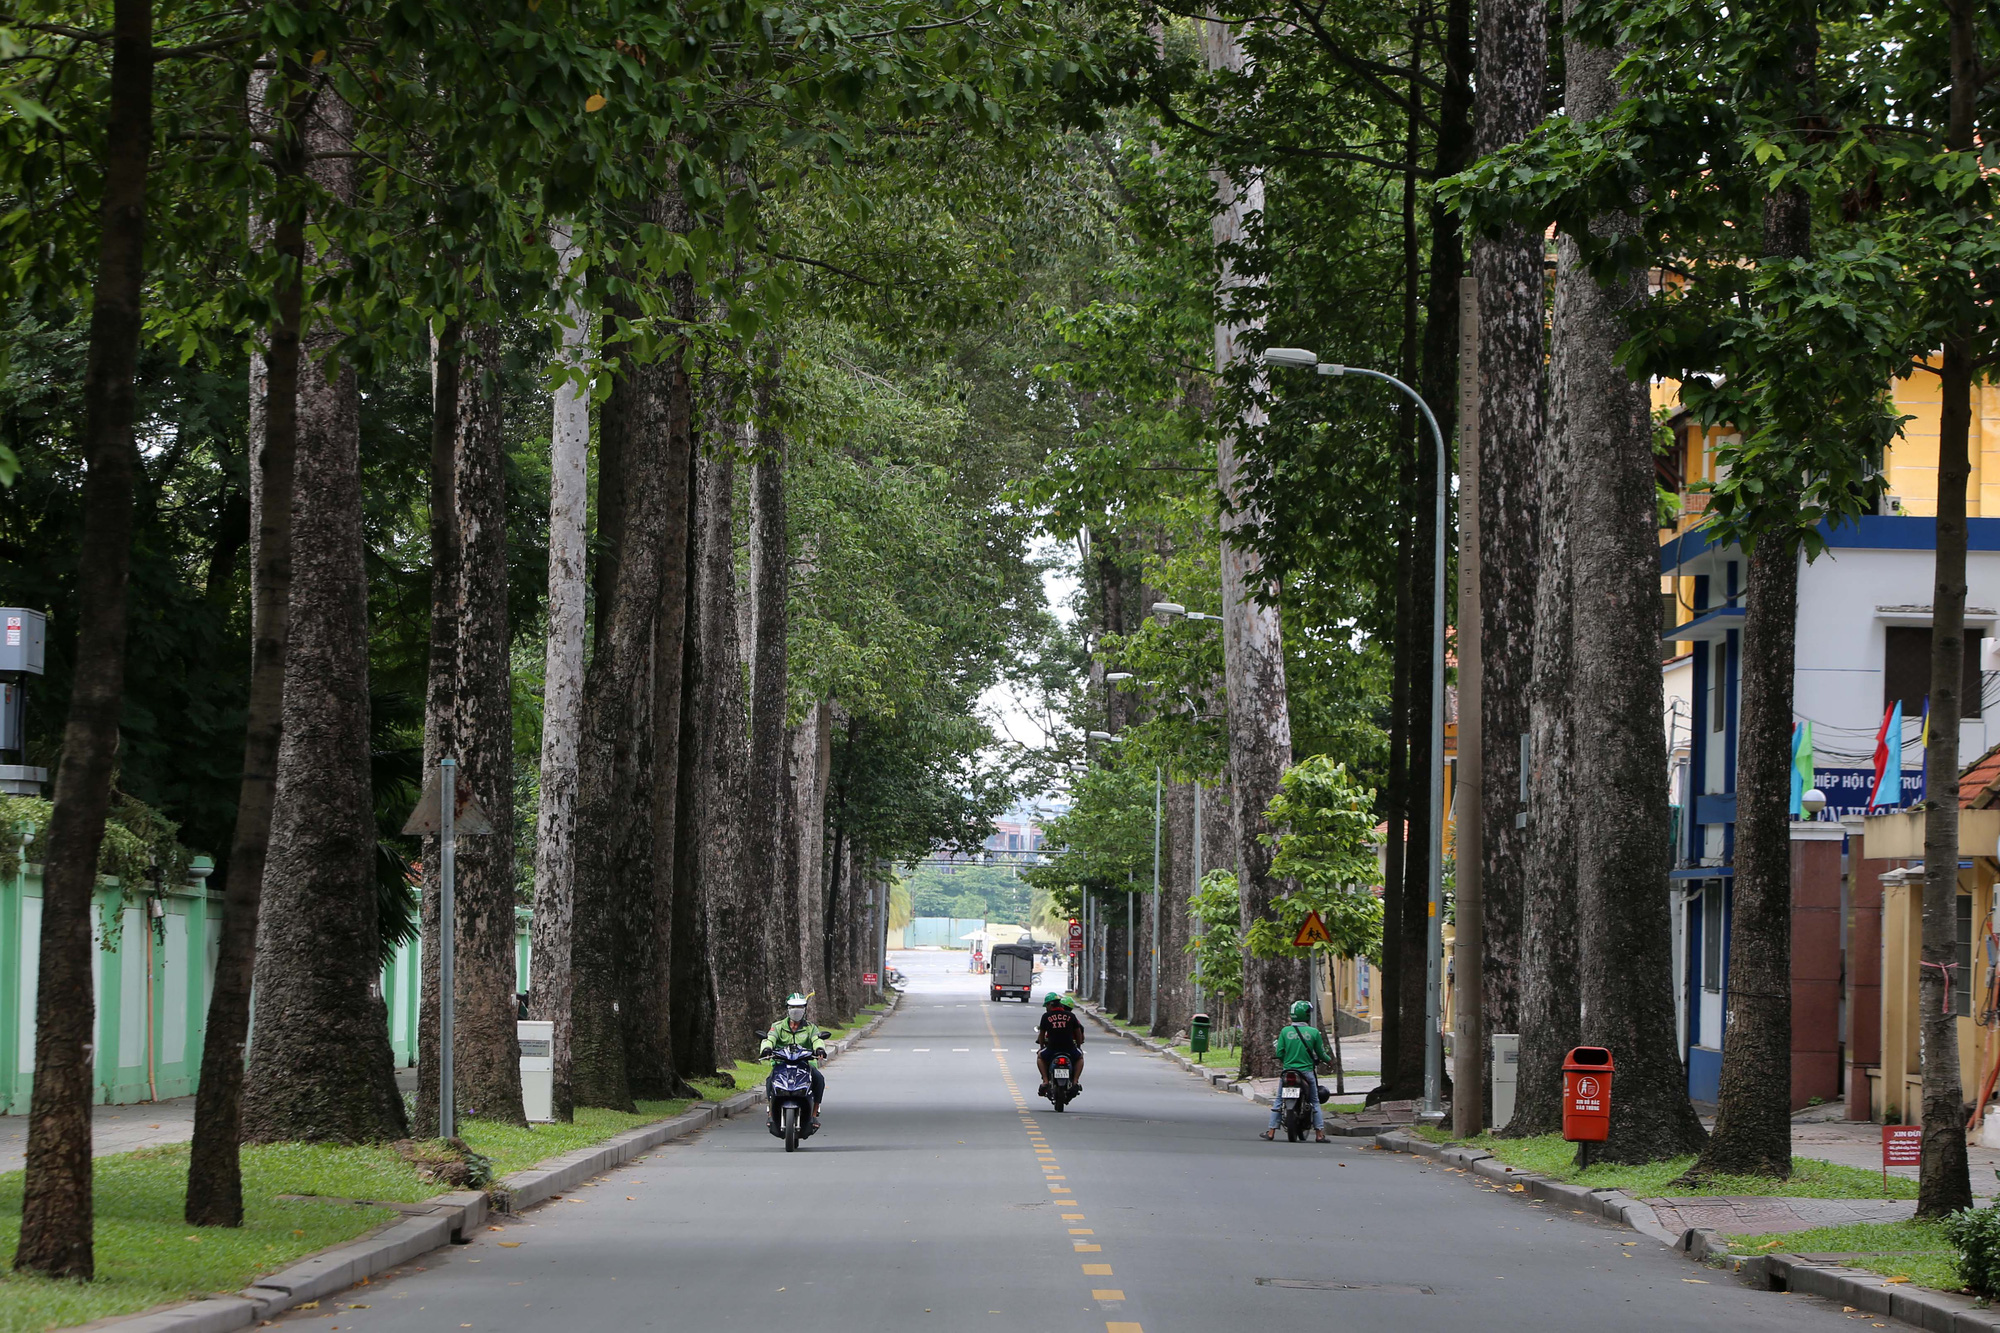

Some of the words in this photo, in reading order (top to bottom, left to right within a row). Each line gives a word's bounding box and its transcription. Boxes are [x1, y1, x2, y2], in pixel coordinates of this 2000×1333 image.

[1842, 773, 1864, 790] HỘI
[1047, 1014, 1071, 1023] GUCCI
[1052, 1021, 1067, 1029] XXV
[1893, 1130, 1907, 1138] XIN
